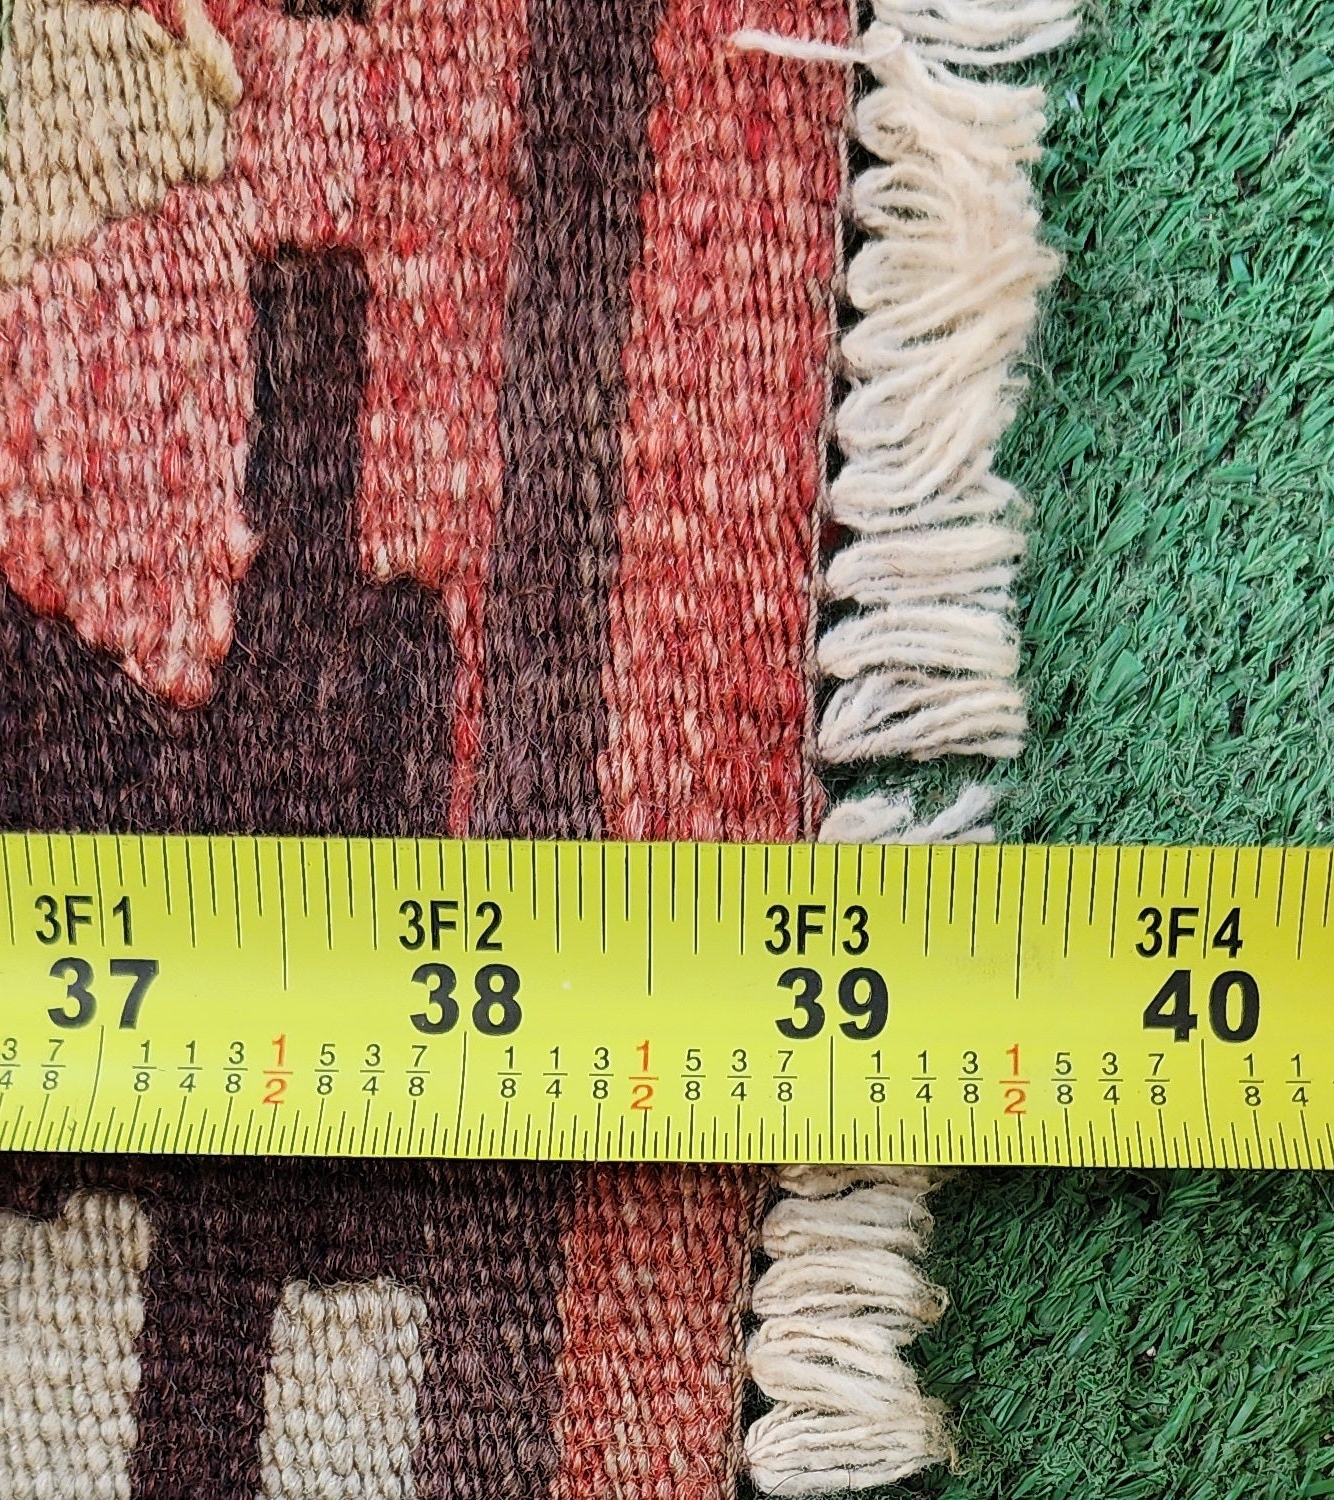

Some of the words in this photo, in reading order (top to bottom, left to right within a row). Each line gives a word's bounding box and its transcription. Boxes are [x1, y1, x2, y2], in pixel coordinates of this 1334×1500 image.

[47, 957, 159, 1030] 37
[410, 962, 522, 1036] 38
[775, 967, 888, 1041] 39
[1143, 969, 1260, 1043] 40
